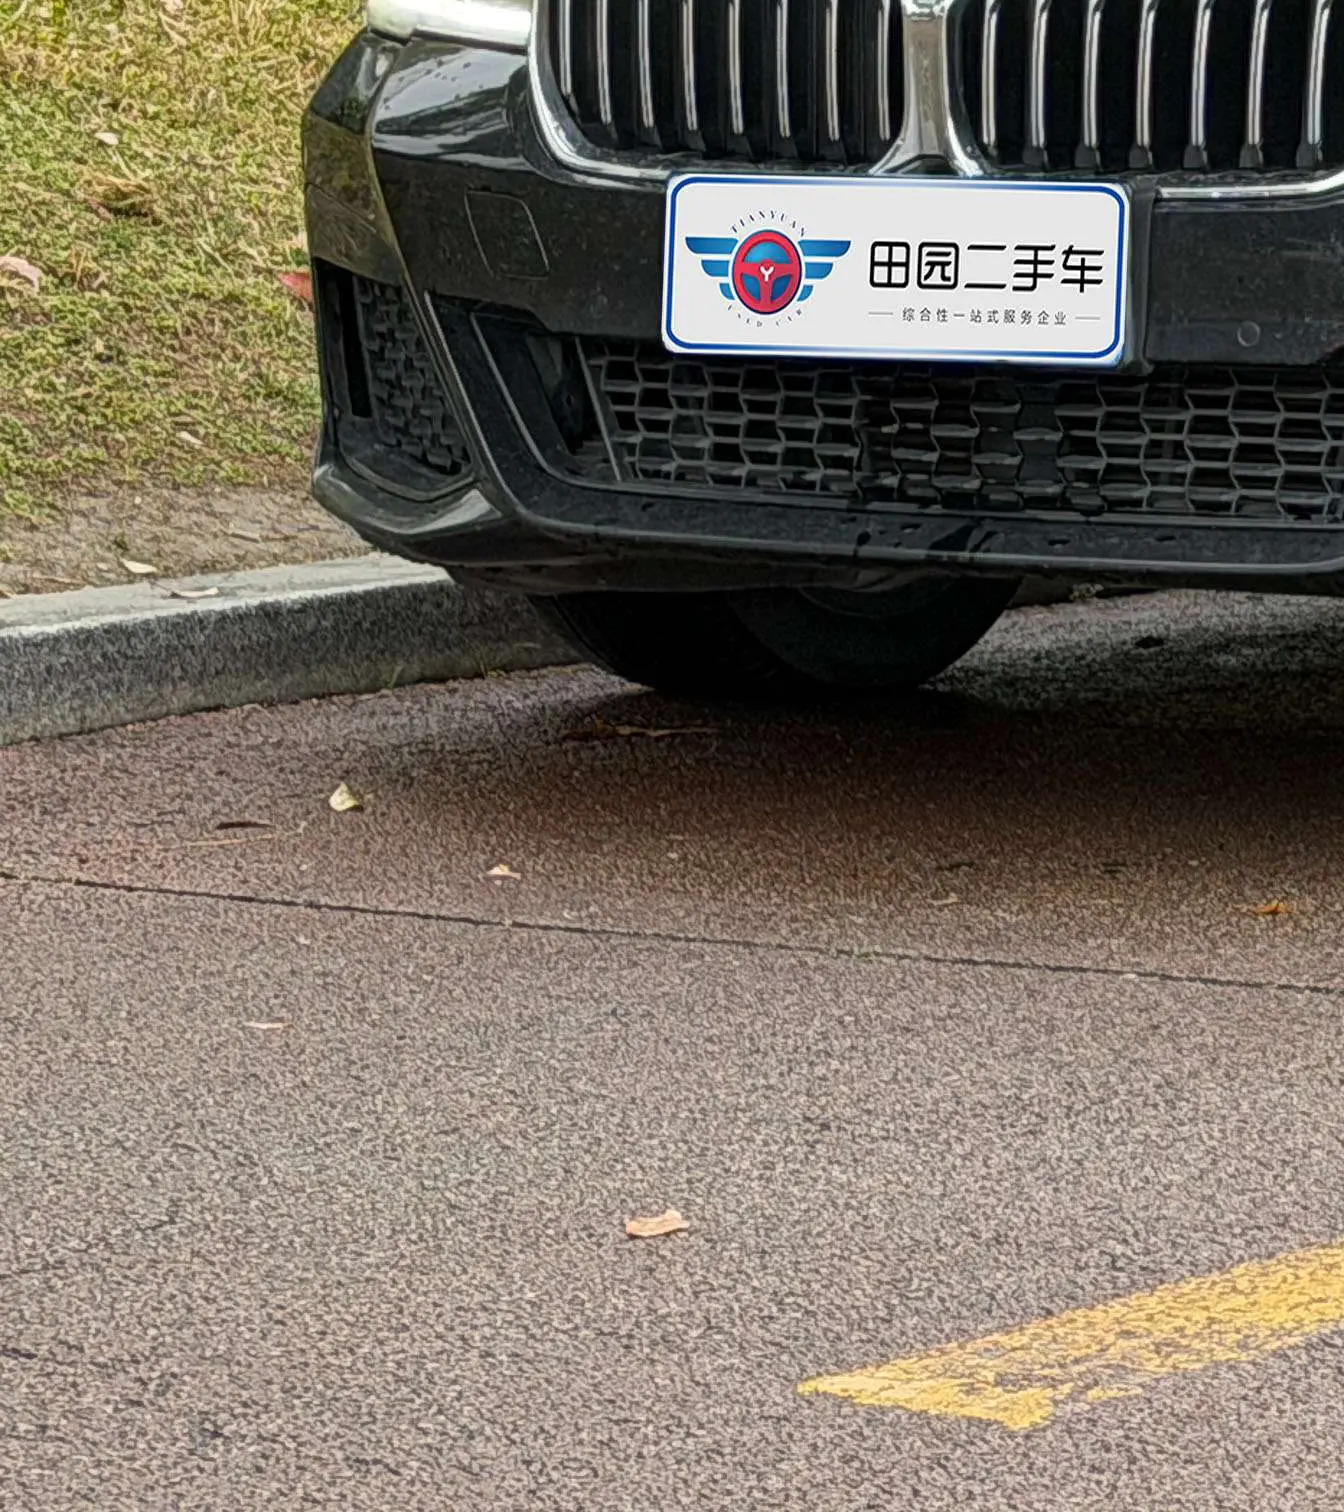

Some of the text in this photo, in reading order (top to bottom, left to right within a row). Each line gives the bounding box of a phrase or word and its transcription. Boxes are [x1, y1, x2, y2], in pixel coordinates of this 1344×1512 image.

[869, 240, 1105, 294] 田园二手车
[902, 307, 1067, 326] 综合性一站式服务企业
